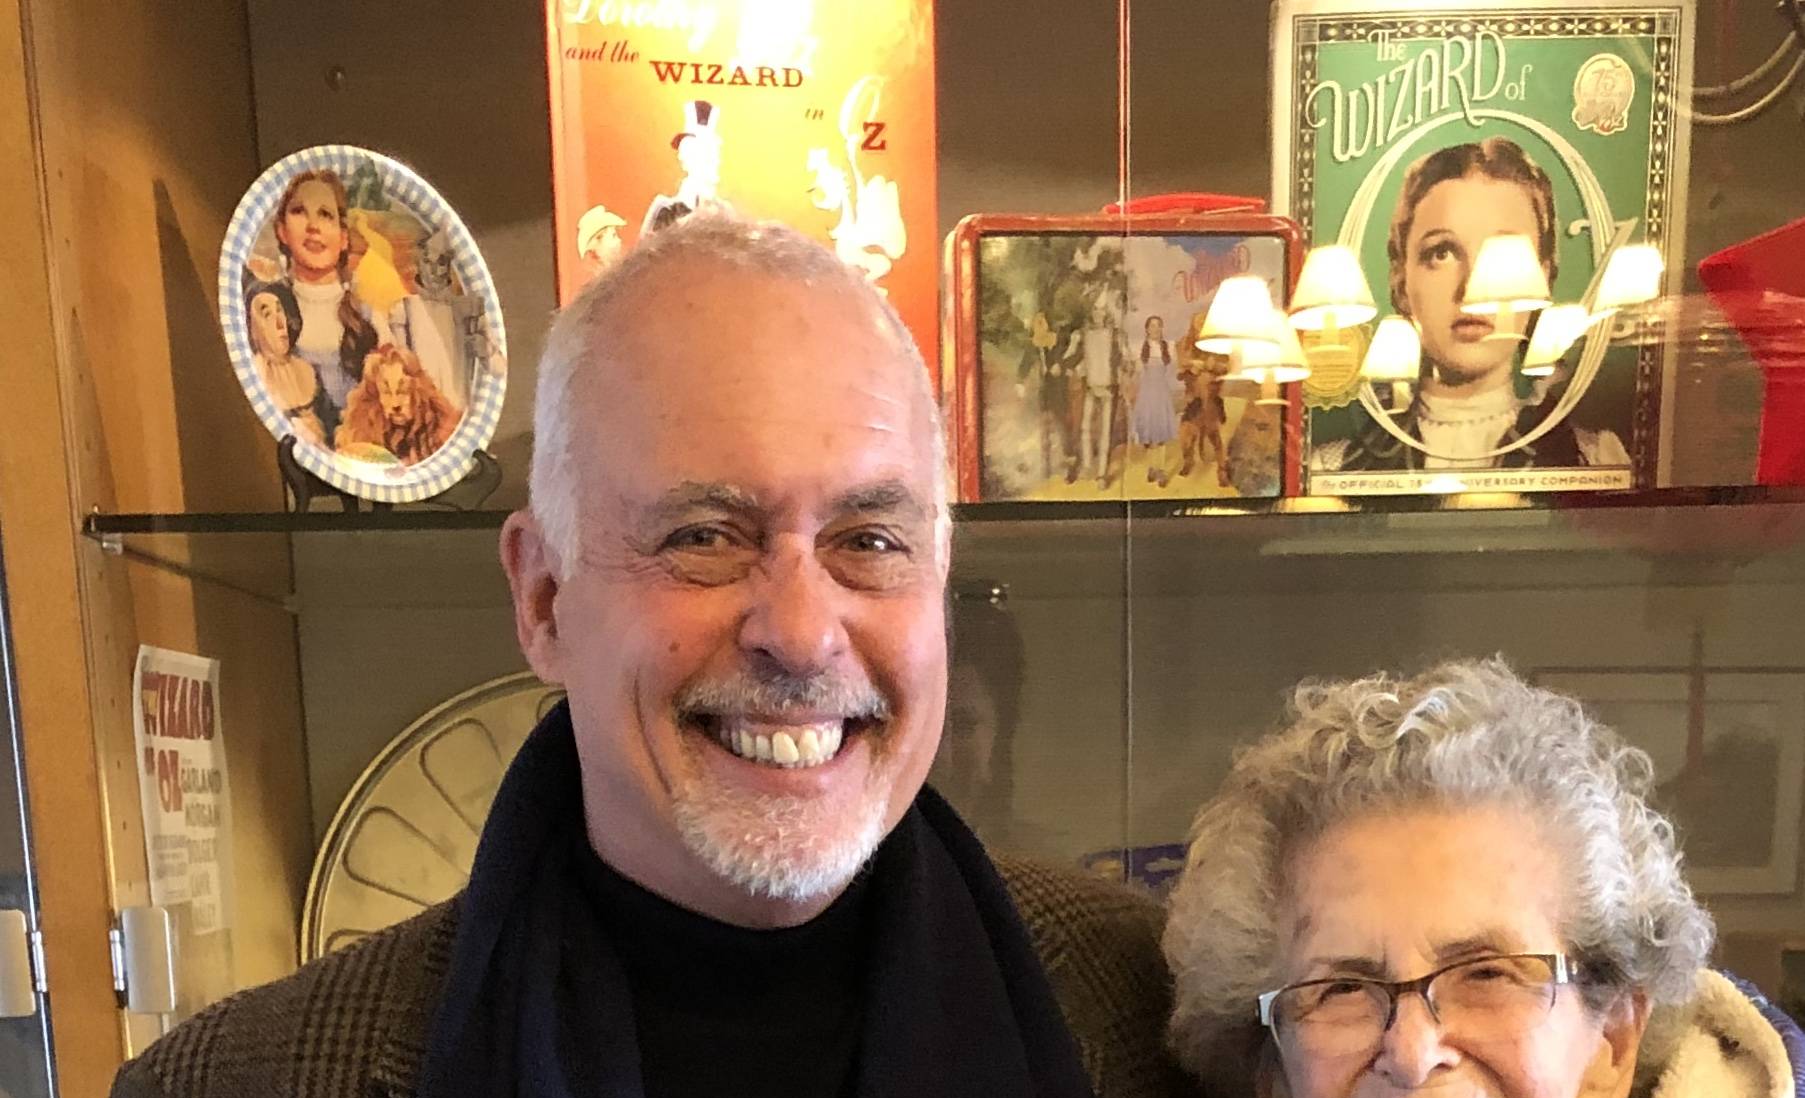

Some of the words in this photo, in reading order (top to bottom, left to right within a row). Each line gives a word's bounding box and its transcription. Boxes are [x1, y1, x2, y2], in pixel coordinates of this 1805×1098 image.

[565, 41, 606, 61] and
[610, 40, 640, 63] the
[1368, 28, 1408, 61] The
[649, 60, 803, 87] WIZARD
[1305, 30, 1506, 162] WIZARD
[1505, 64, 1533, 100] of
[804, 108, 824, 120] in
[1338, 479, 1404, 490] OFFICIAL
[1540, 475, 1623, 487] COMPANION
